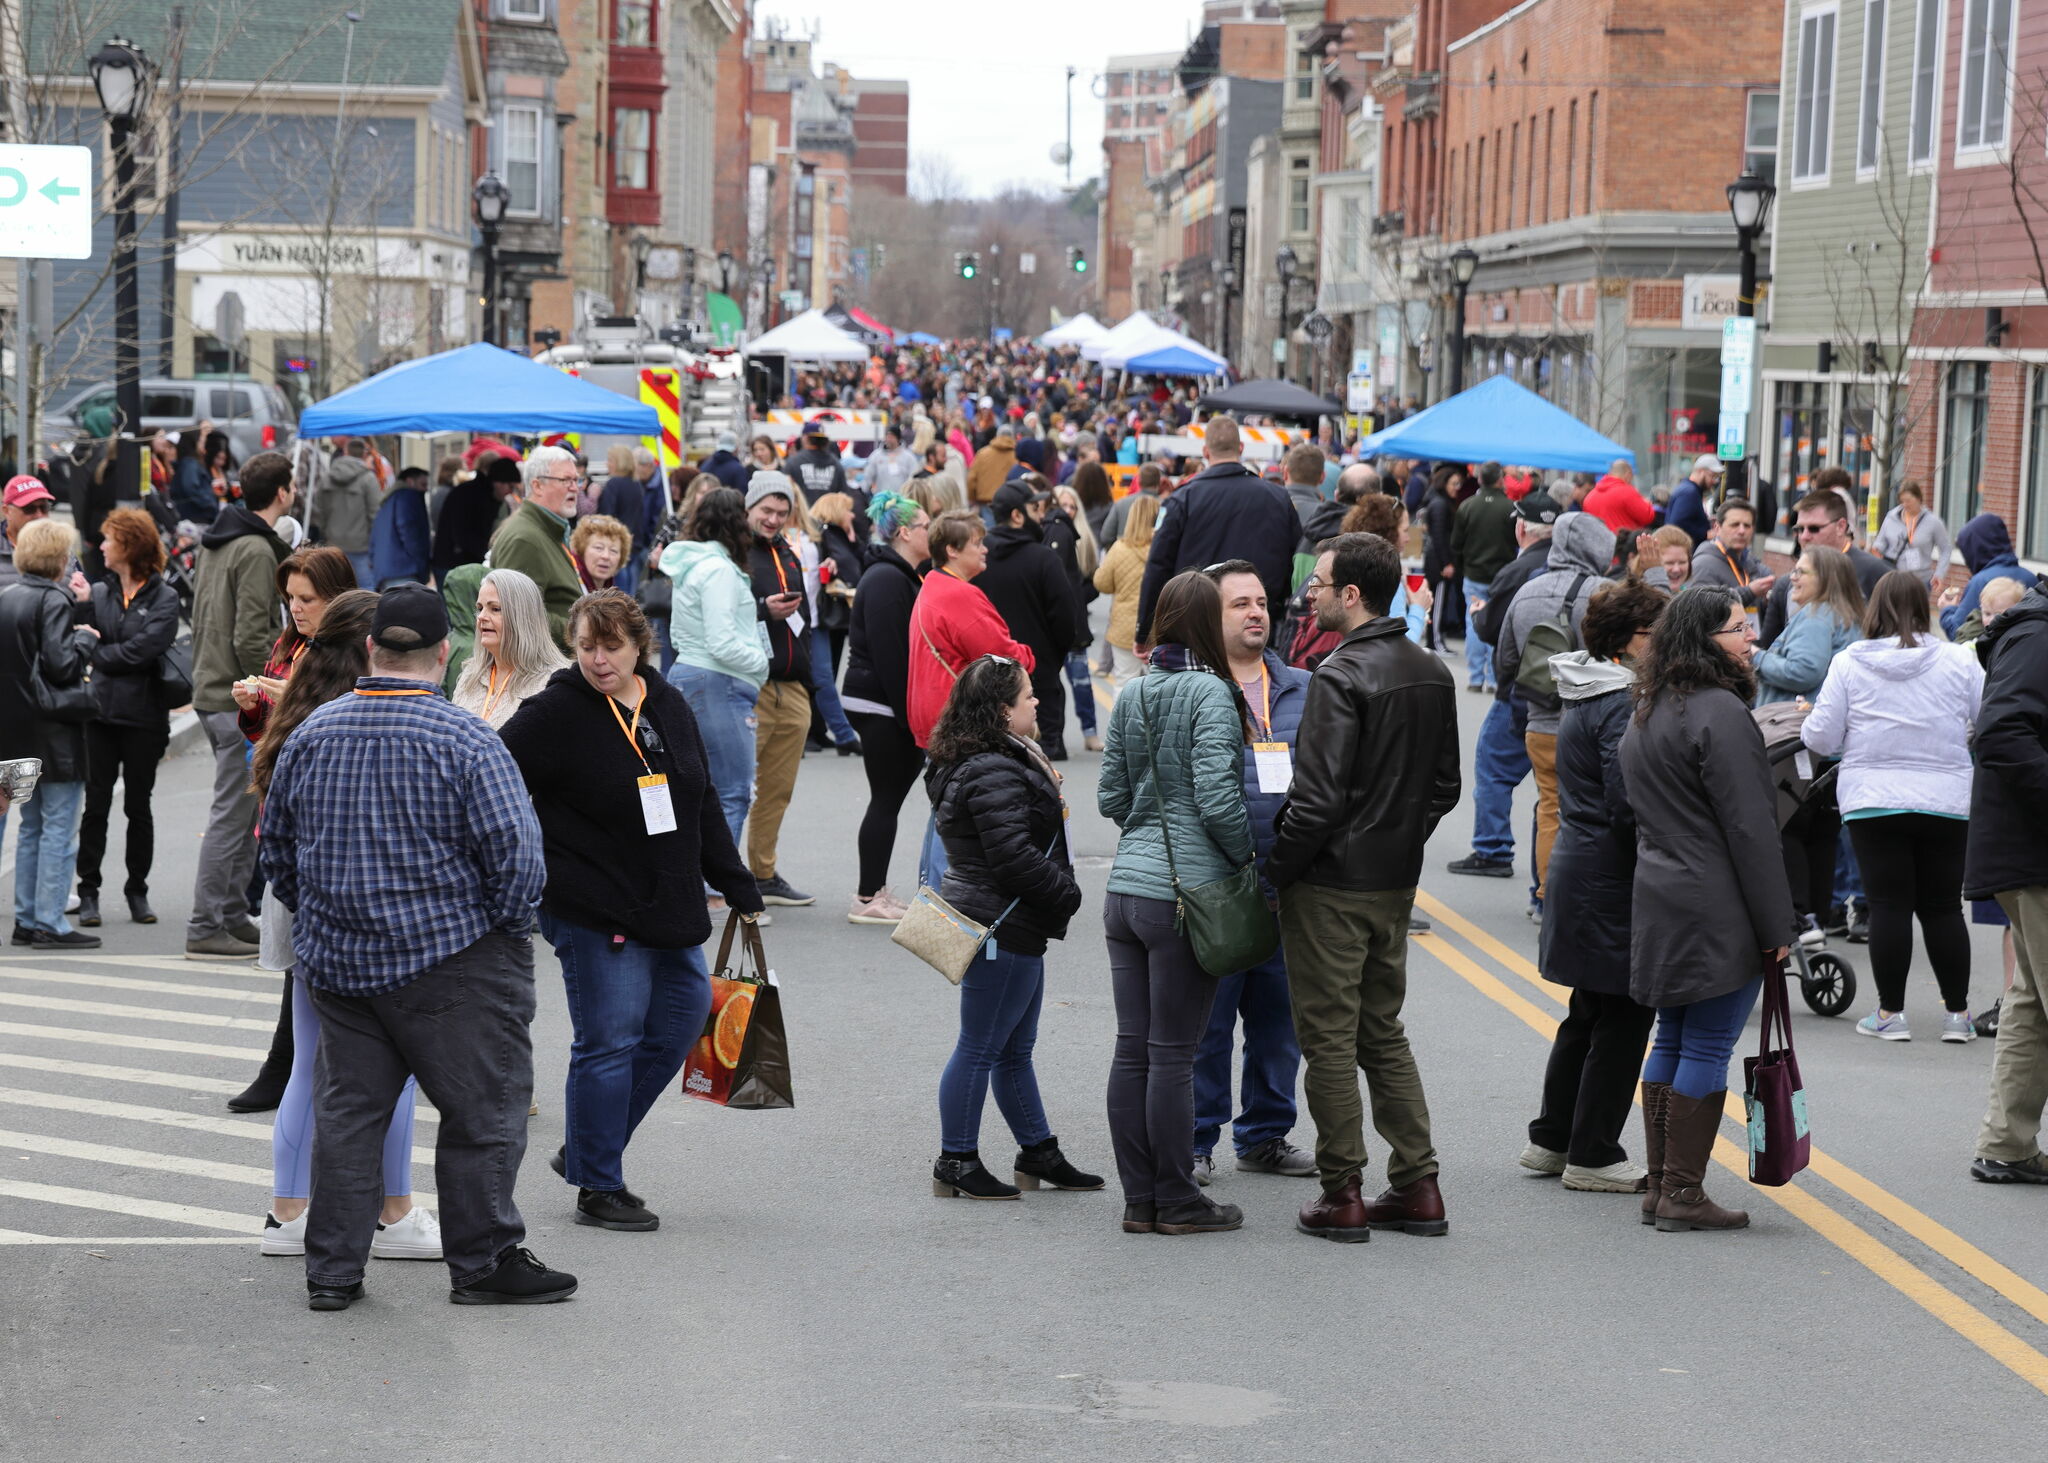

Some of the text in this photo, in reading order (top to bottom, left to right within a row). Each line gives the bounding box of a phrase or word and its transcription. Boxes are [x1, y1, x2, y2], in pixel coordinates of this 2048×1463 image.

[233, 244, 282, 261] YUAN
[332, 246, 364, 264] SPA
[1692, 296, 1738, 315] Loca
